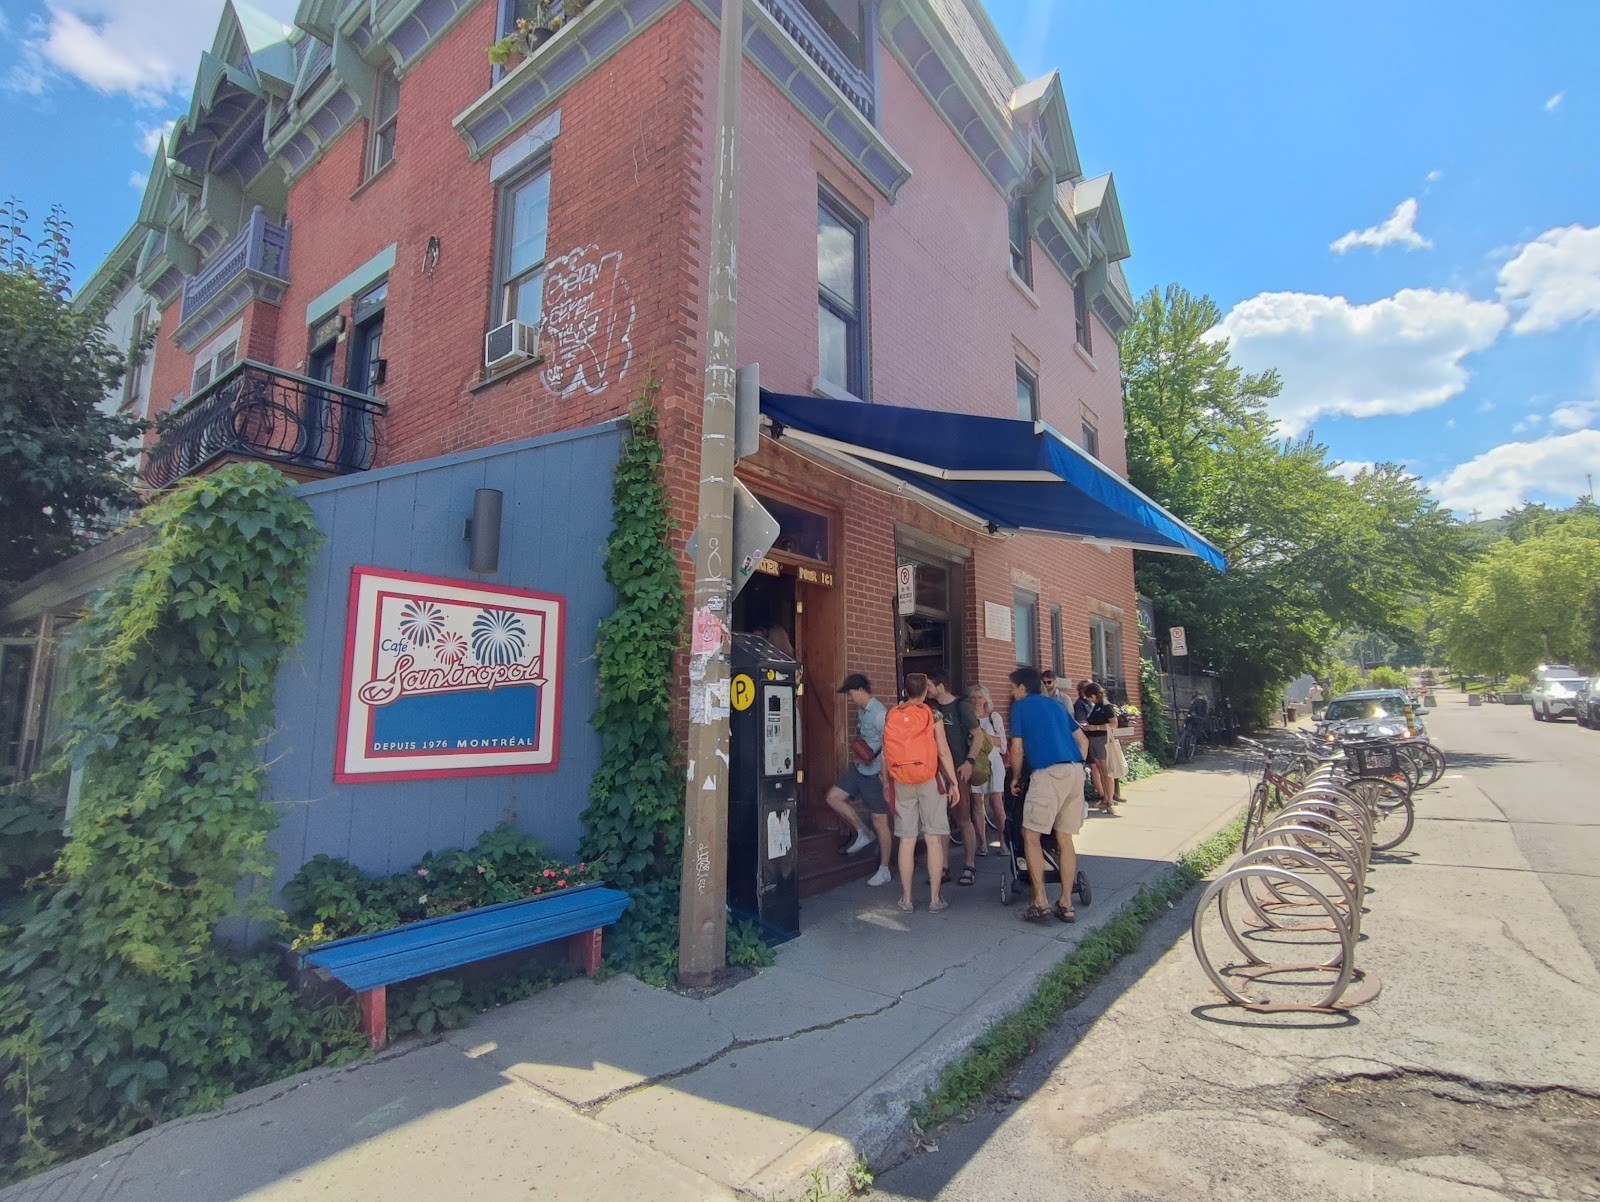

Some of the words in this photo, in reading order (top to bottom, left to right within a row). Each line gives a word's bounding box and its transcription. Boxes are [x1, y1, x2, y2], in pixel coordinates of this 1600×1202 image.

[821, 572, 833, 586] ICI
[381, 638, 409, 657] Café
[358, 654, 548, 706] Santropol
[373, 741, 416, 751] DEPUIS
[422, 740, 448, 749] 1976
[456, 736, 534, 748] MONTRÉAL
